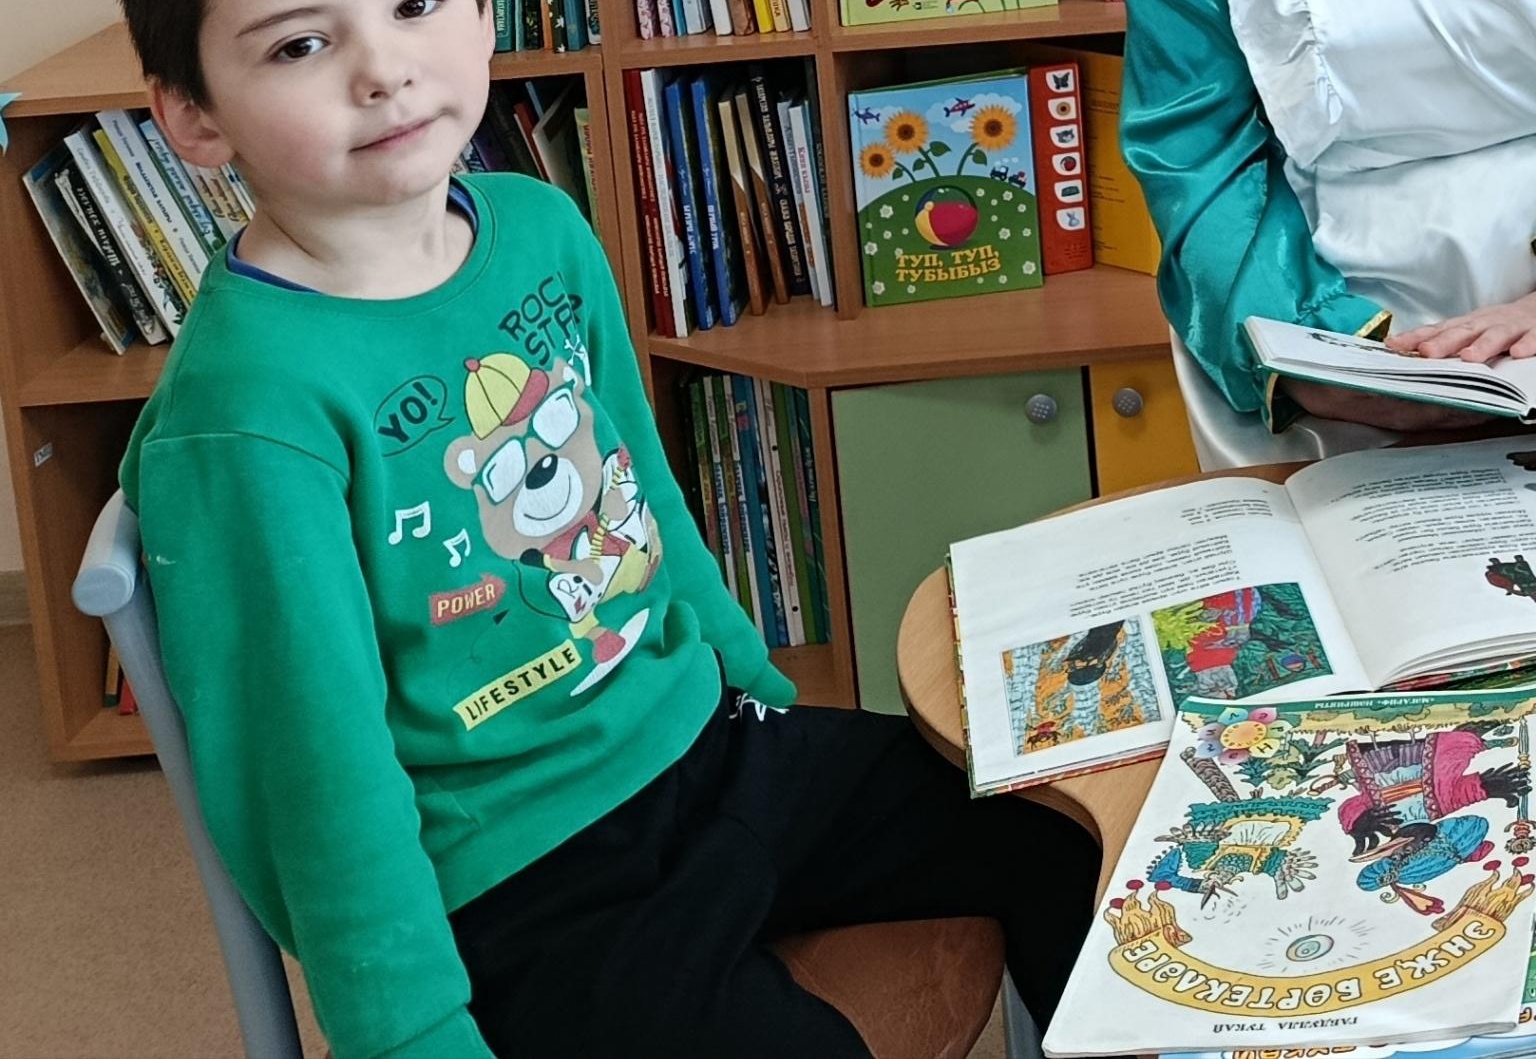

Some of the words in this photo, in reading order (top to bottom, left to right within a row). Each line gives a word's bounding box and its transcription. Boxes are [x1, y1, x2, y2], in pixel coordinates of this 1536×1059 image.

[895, 258, 1001, 282] ТУБЫБЫЗ
[897, 253, 943, 267] ТУП,
[951, 244, 999, 264] ТУП,
[499, 271, 566, 339] ROC
[378, 381, 440, 444] YO!
[436, 583, 496, 617] POWER
[465, 646, 576, 723] LIFESTYLE
[1120, 939, 1361, 1010] БӨРТЕКЛӘРЕ
[1371, 918, 1497, 991] ЭНҖЕ
[1211, 1021, 1266, 1034] ТУКАЙ
[1276, 1016, 1358, 1031] ГАБДУЛЛА
